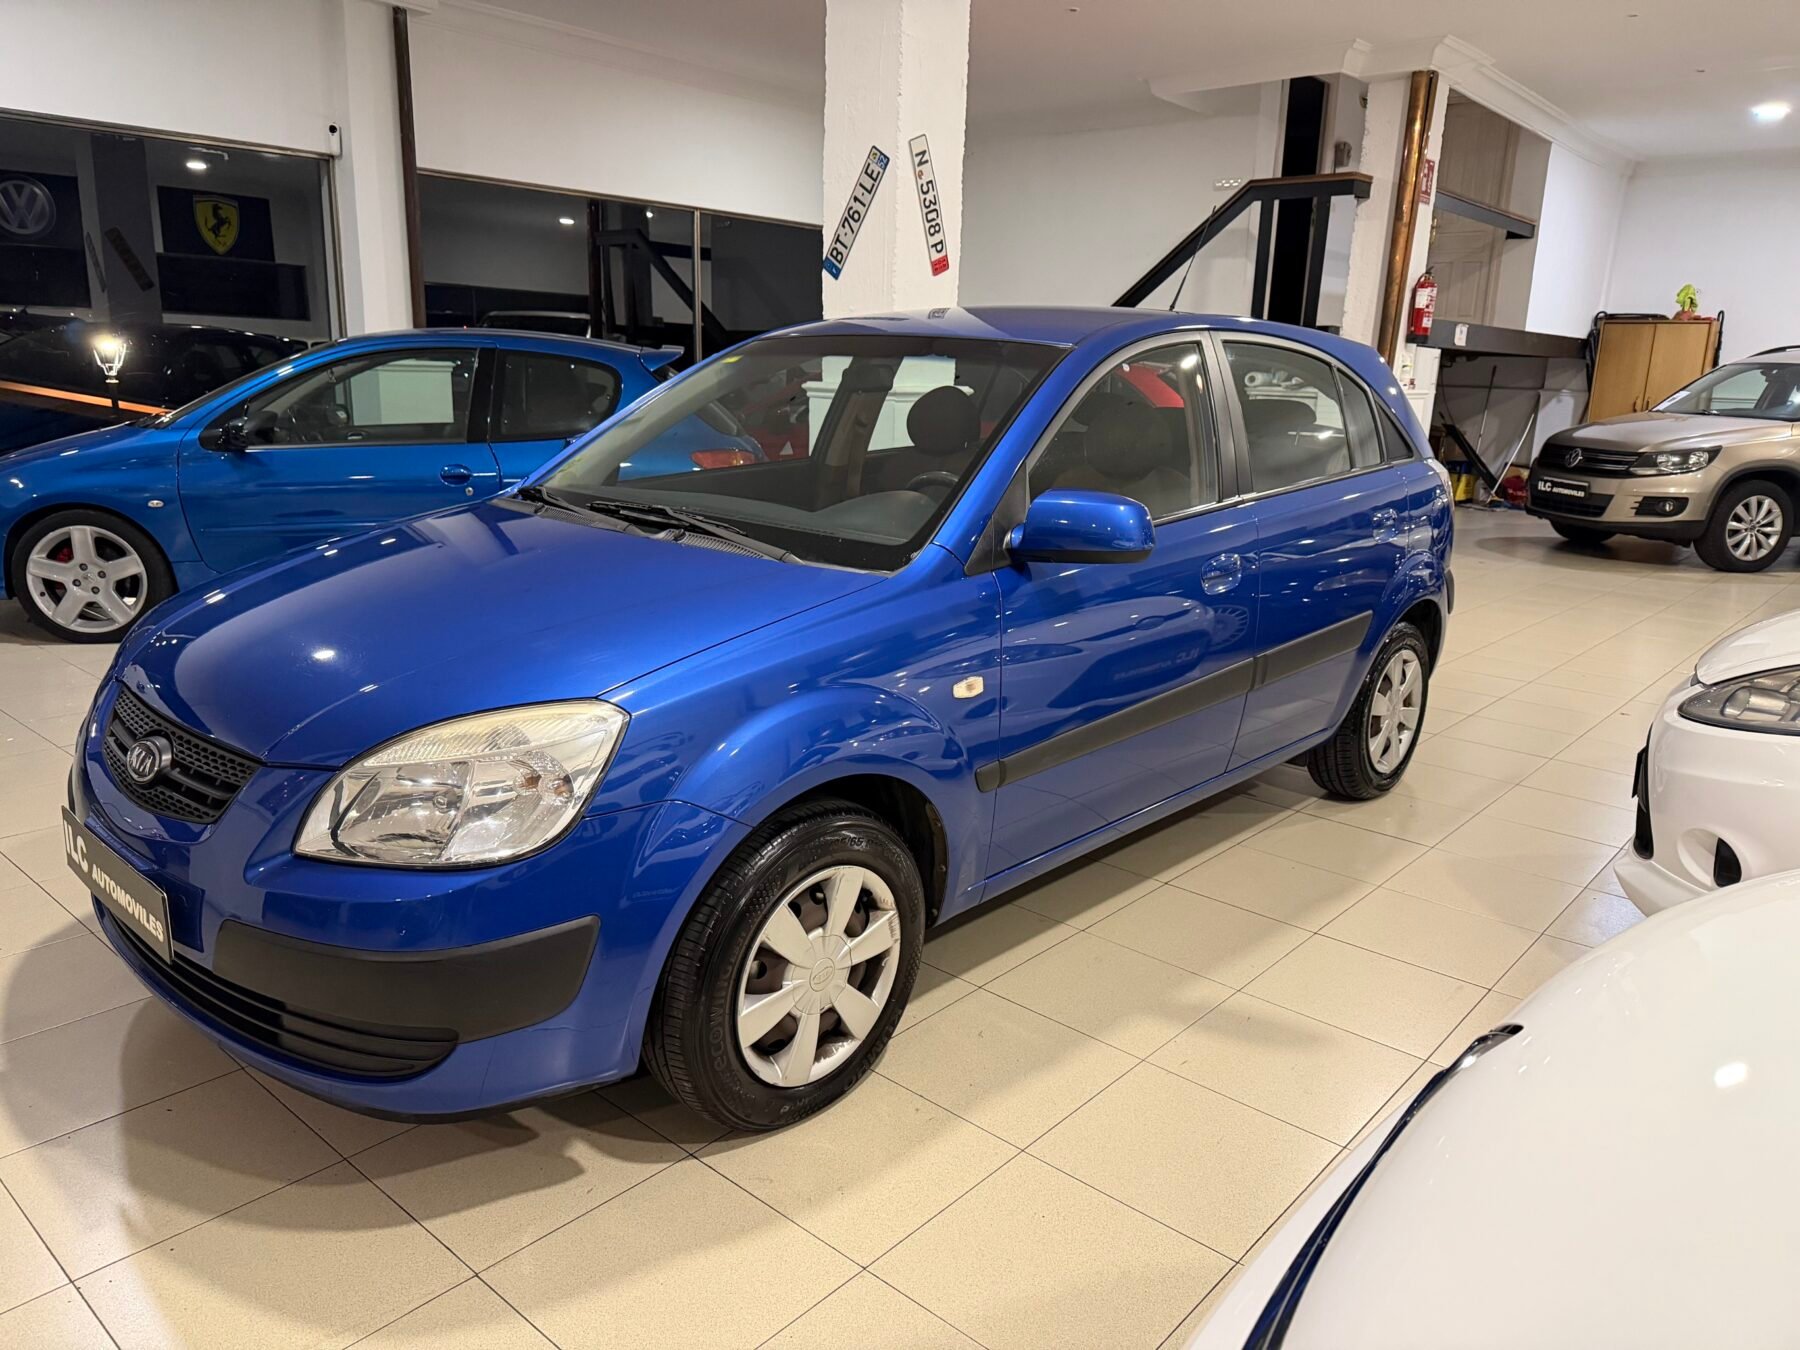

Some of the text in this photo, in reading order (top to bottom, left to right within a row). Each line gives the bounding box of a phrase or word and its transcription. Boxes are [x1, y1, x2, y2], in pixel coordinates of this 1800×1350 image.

[915, 150, 929, 167] N
[830, 163, 880, 264] BT-761-LE
[920, 180, 941, 237] 5308
[931, 239, 944, 254] P
[1538, 480, 1552, 492] ILC
[63, 819, 164, 943] ILC AUTOMOVILES
